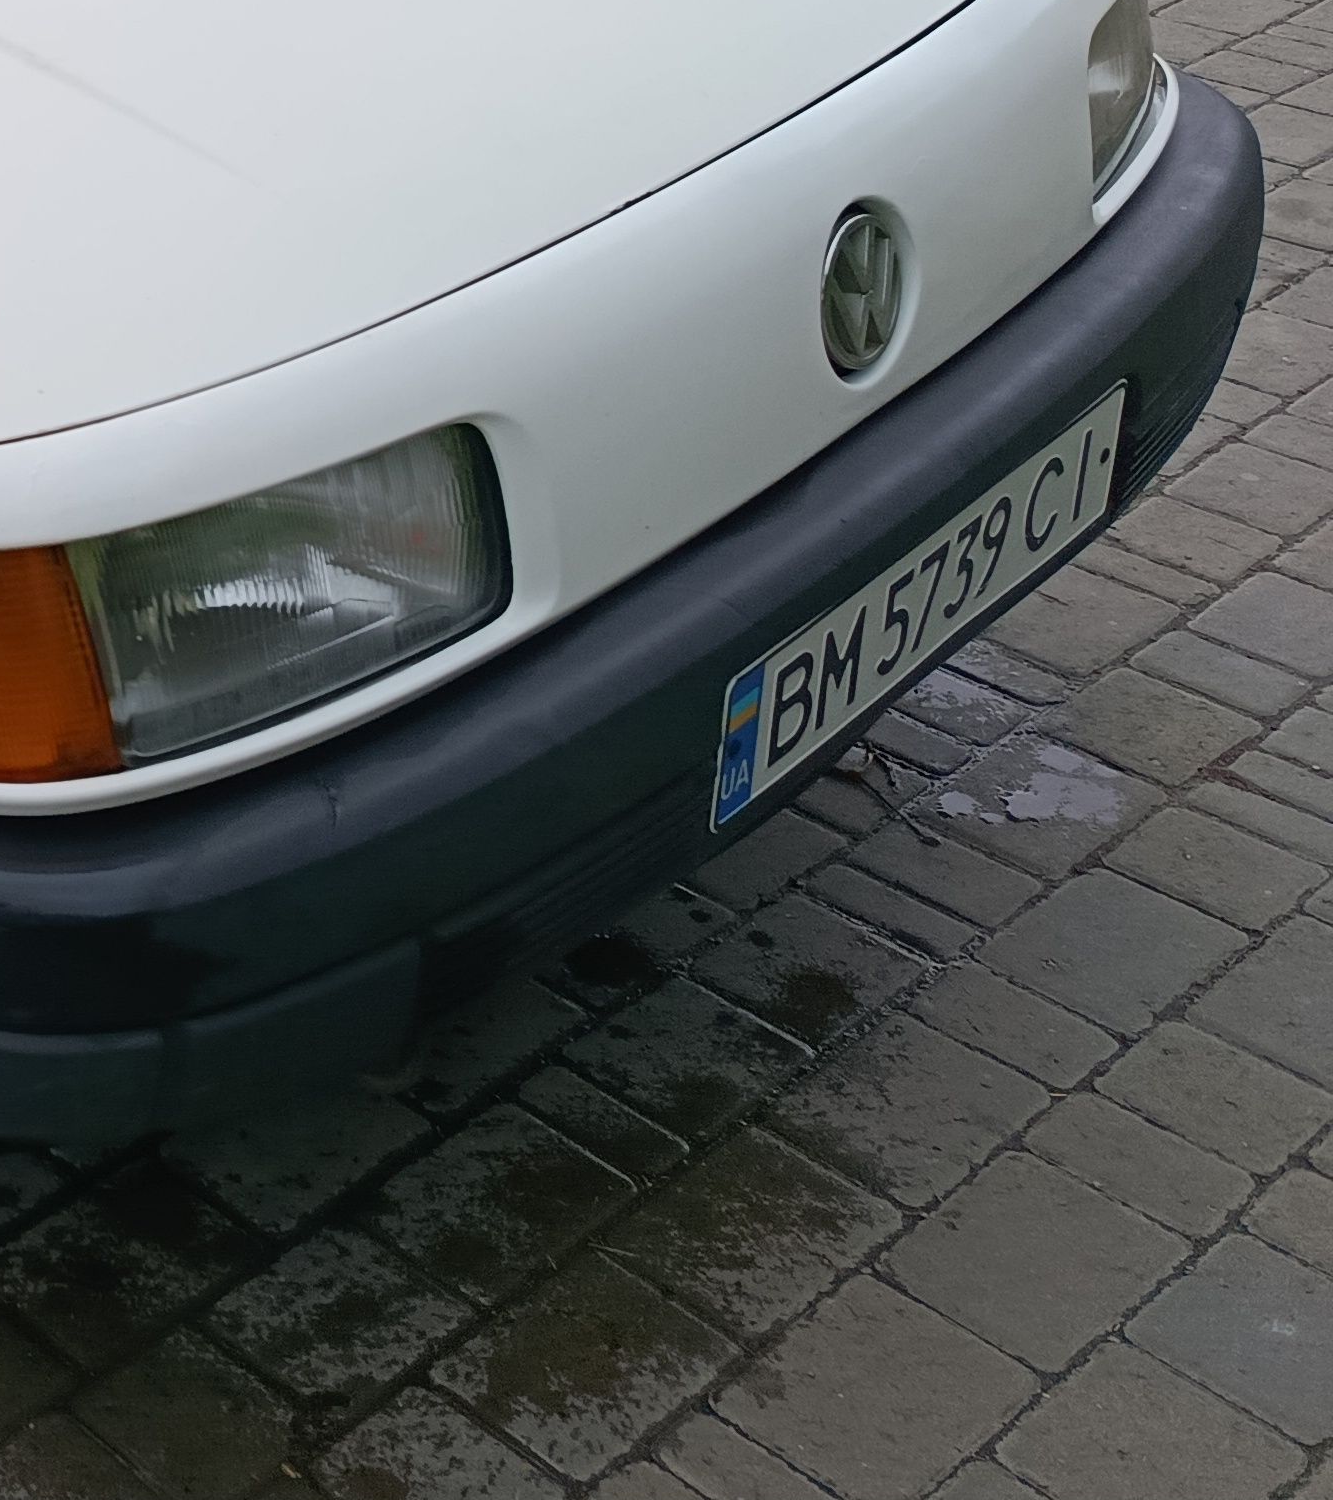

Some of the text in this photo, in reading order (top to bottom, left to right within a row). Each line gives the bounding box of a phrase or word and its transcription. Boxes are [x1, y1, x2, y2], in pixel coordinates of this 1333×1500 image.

[767, 427, 1094, 768] BM 5739 CI
[721, 759, 749, 800] UA
